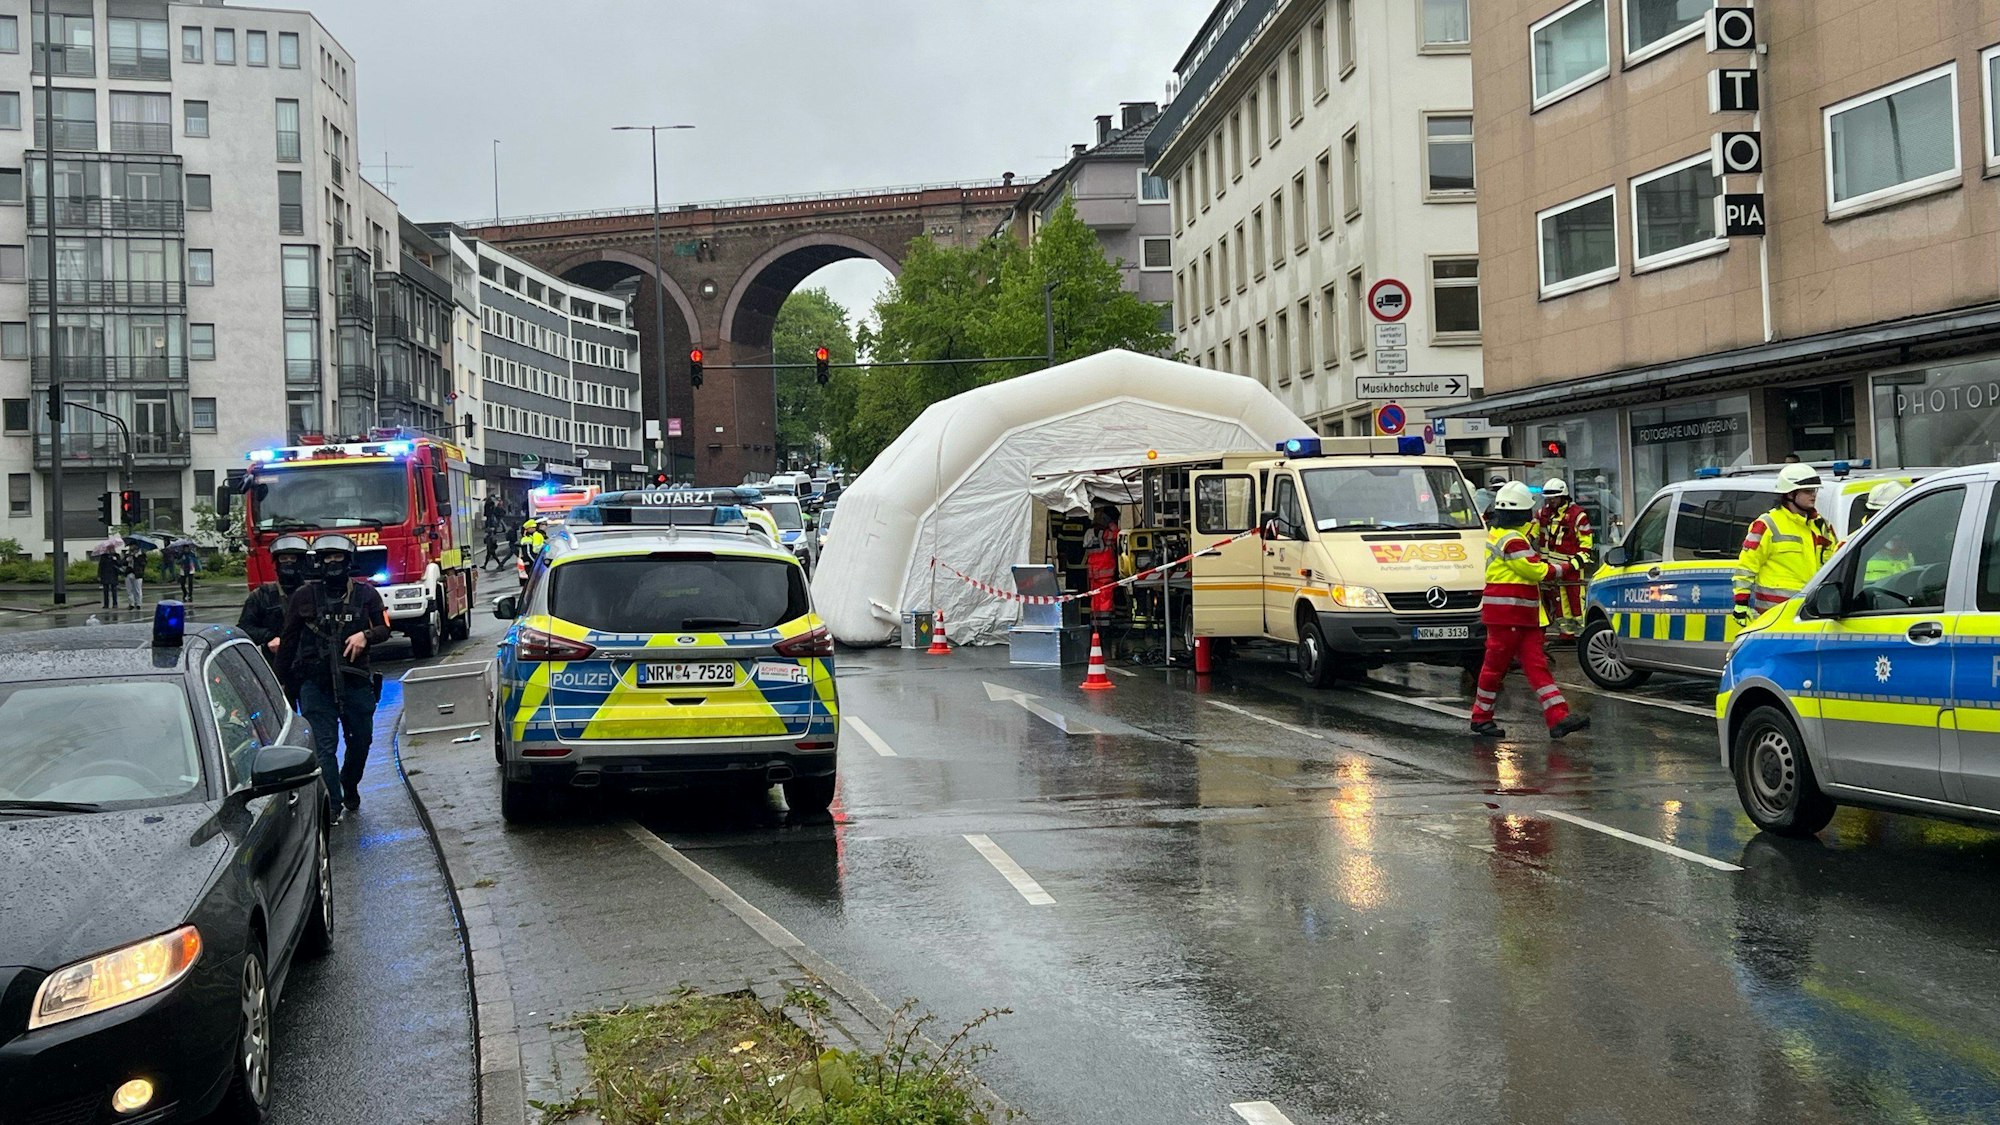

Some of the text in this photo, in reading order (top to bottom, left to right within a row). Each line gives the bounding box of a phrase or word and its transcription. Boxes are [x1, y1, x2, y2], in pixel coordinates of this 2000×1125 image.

[1362, 382, 1439, 394] Musikhochschule
[1640, 418, 1738, 441] FOTOGRAFIE UND WERBUNG
[641, 490, 715, 505] NOTARZT
[1399, 543, 1467, 562] ASB
[1418, 628, 1434, 638] NRW
[1447, 627, 1468, 637] 3136
[552, 673, 613, 687] POLIZEI
[646, 664, 733, 681] NRW 4-7528
